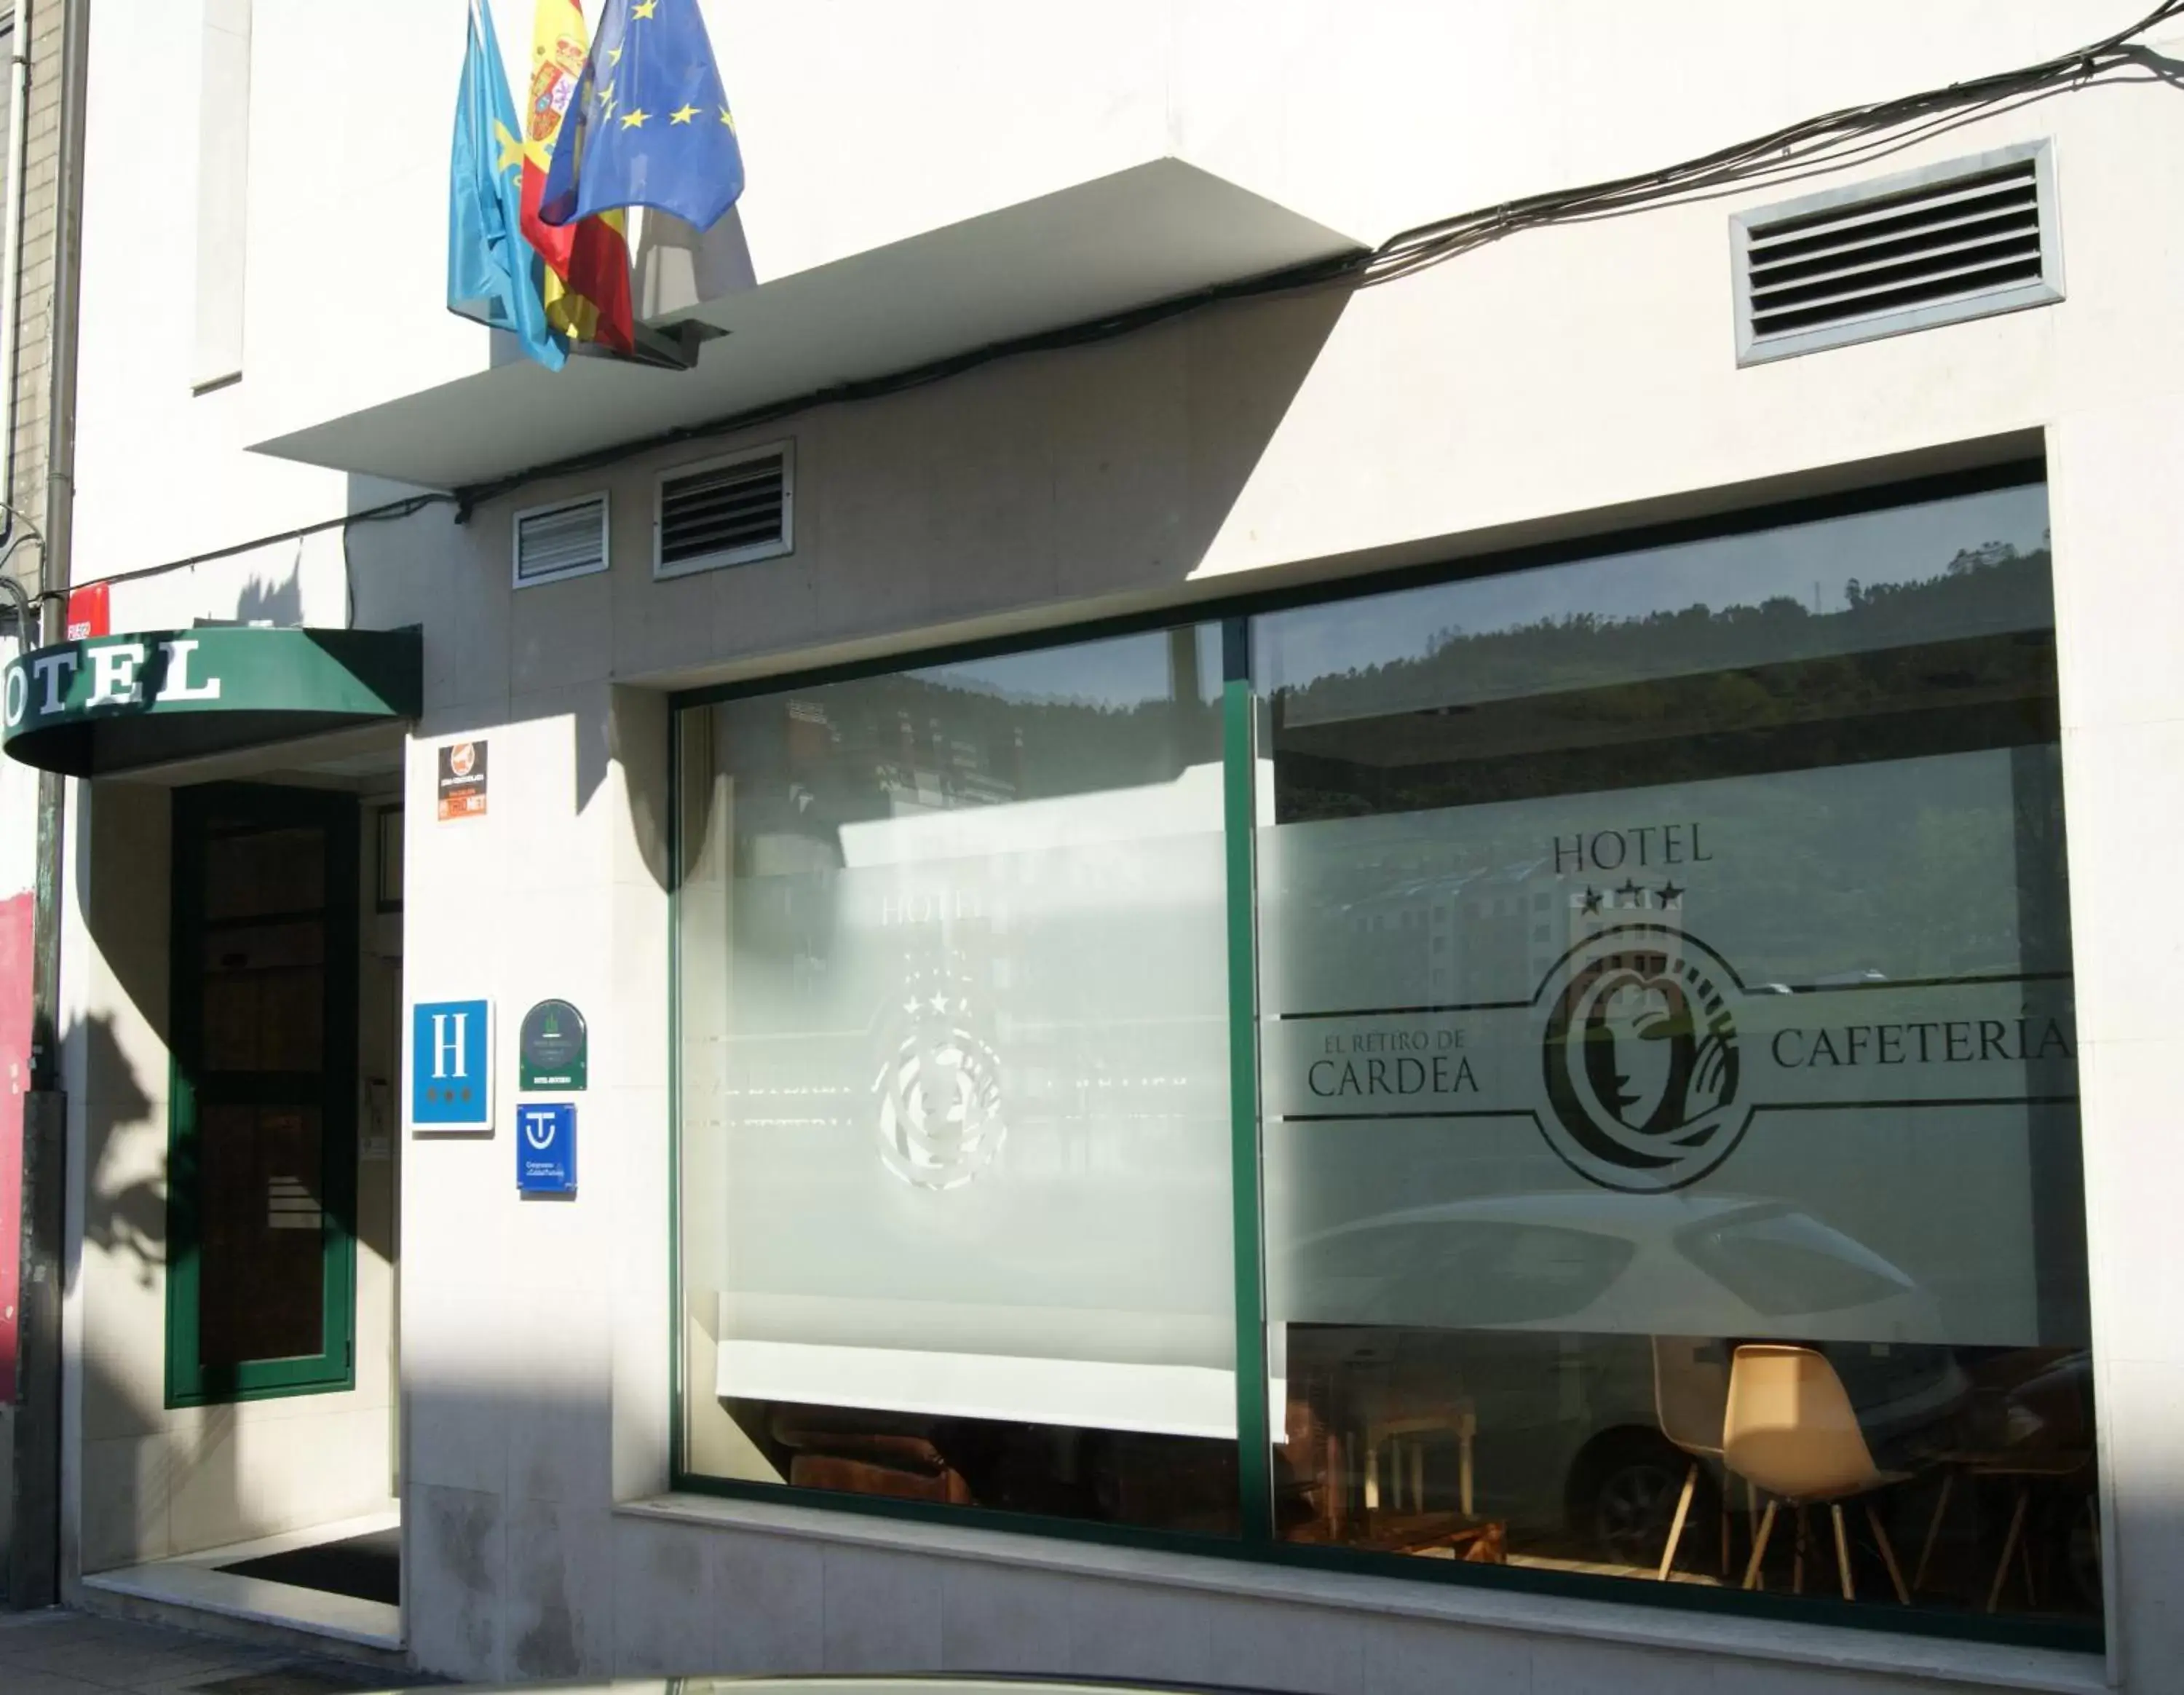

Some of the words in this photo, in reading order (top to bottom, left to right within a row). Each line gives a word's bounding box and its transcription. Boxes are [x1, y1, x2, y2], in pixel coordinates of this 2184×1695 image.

[6, 640, 221, 727] OTEL
[1552, 822, 1713, 874] HOTEL
[431, 1012, 469, 1078] H
[1324, 1033, 1346, 1055] EL
[1352, 1030, 1430, 1054] RETIRO
[1436, 1027, 1465, 1049] DE
[1770, 1002, 2077, 1069] CAFETERÍA
[1307, 1056, 1480, 1097] CARDEA
